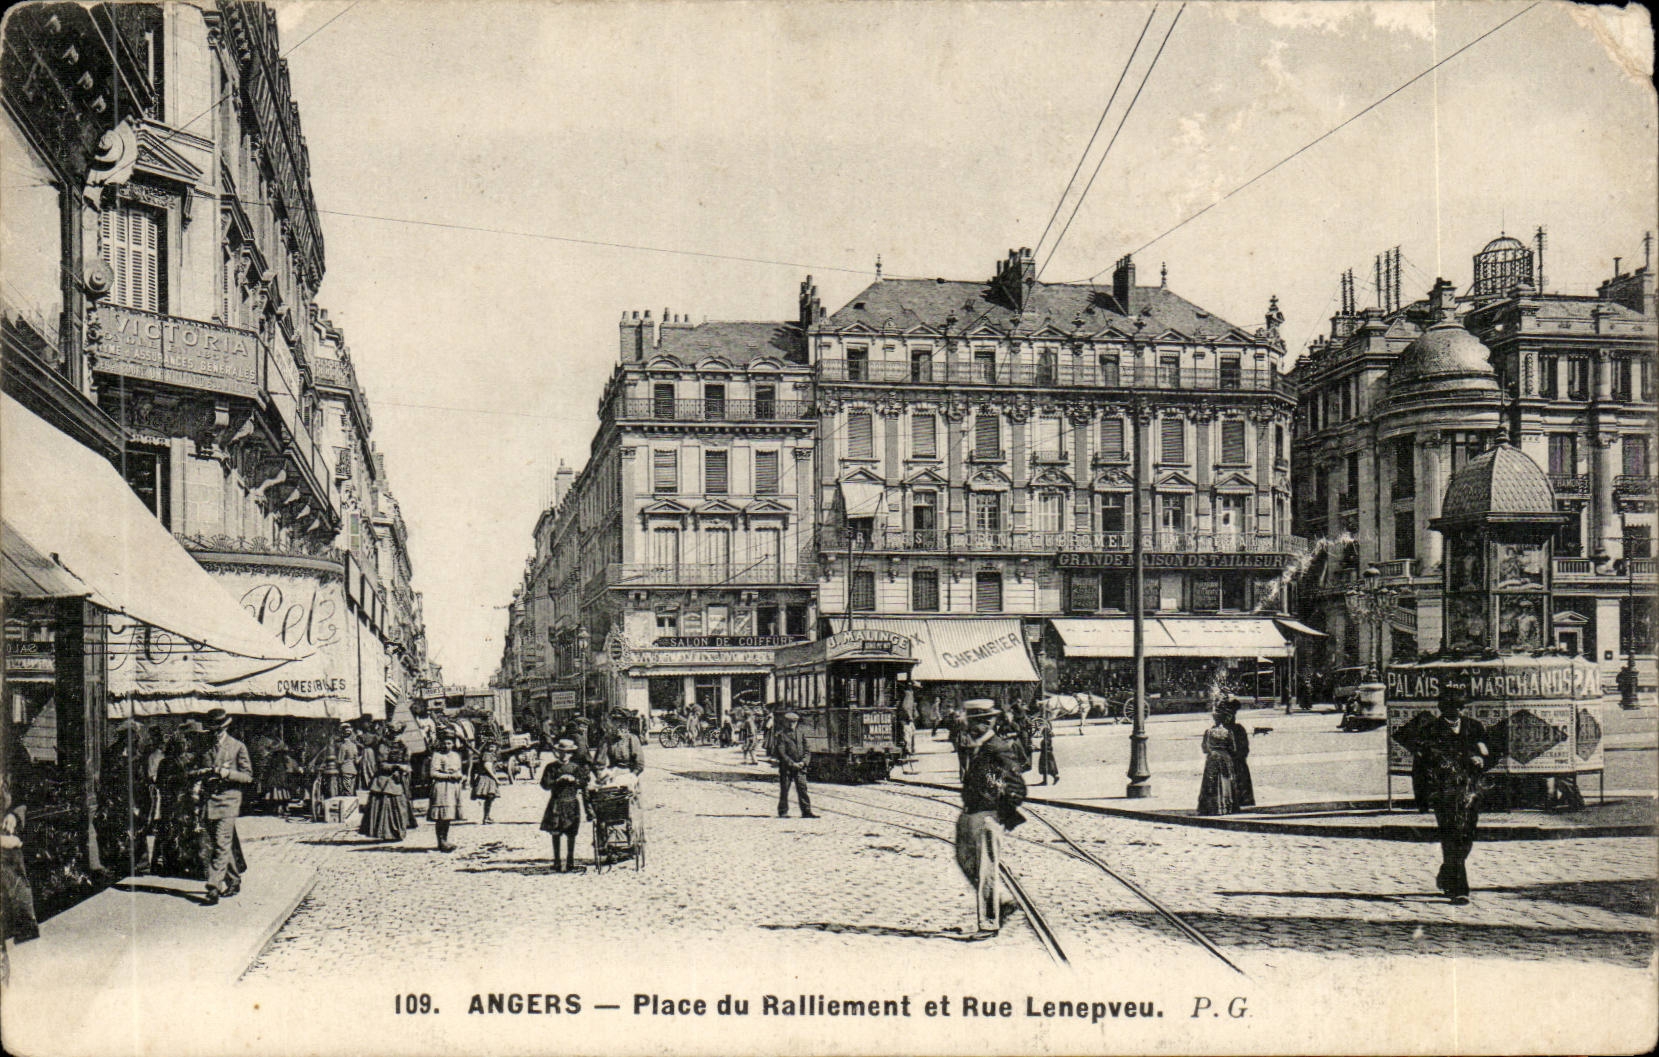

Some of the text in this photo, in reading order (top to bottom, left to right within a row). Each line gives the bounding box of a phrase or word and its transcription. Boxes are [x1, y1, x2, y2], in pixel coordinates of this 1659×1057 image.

[116, 314, 249, 357] VICTORIA
[1058, 553, 1124, 567] GRANDE
[1188, 554, 1211, 567] DE
[670, 636, 794, 647] SALON DE COIFFURE
[942, 632, 1022, 669] CHEMISIER
[1387, 671, 1440, 698] PALAIS
[1471, 667, 1573, 698] MARCHANDS
